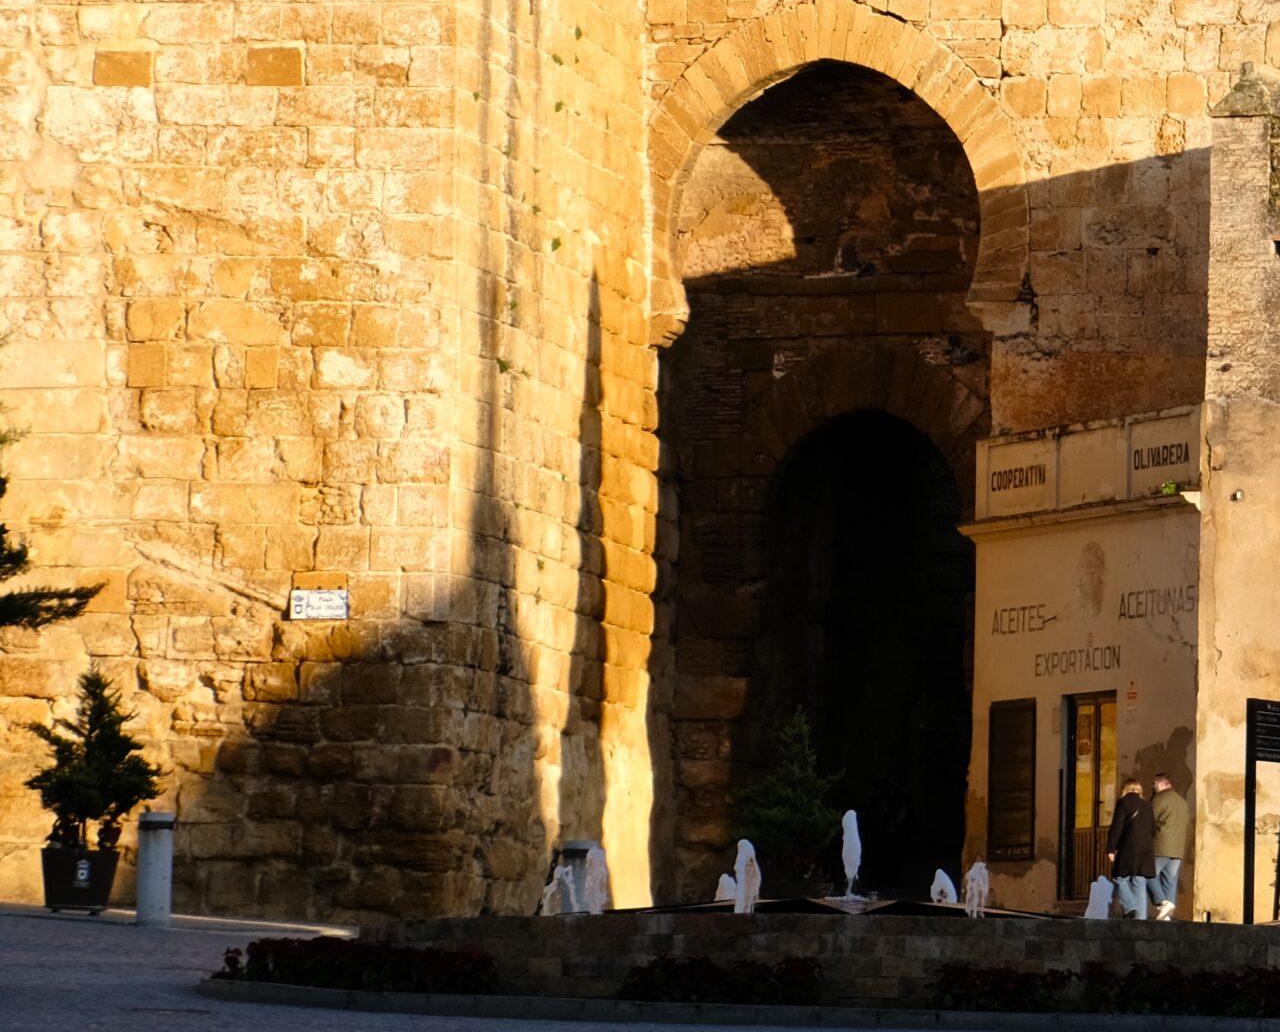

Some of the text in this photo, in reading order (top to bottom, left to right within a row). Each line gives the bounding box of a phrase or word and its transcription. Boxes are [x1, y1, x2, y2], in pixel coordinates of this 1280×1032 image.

[1133, 442, 1190, 471] OLIVARERA
[992, 585, 1195, 635] ACEITES ACEITUNAS
[1035, 645, 1121, 677] EXPORTACION
